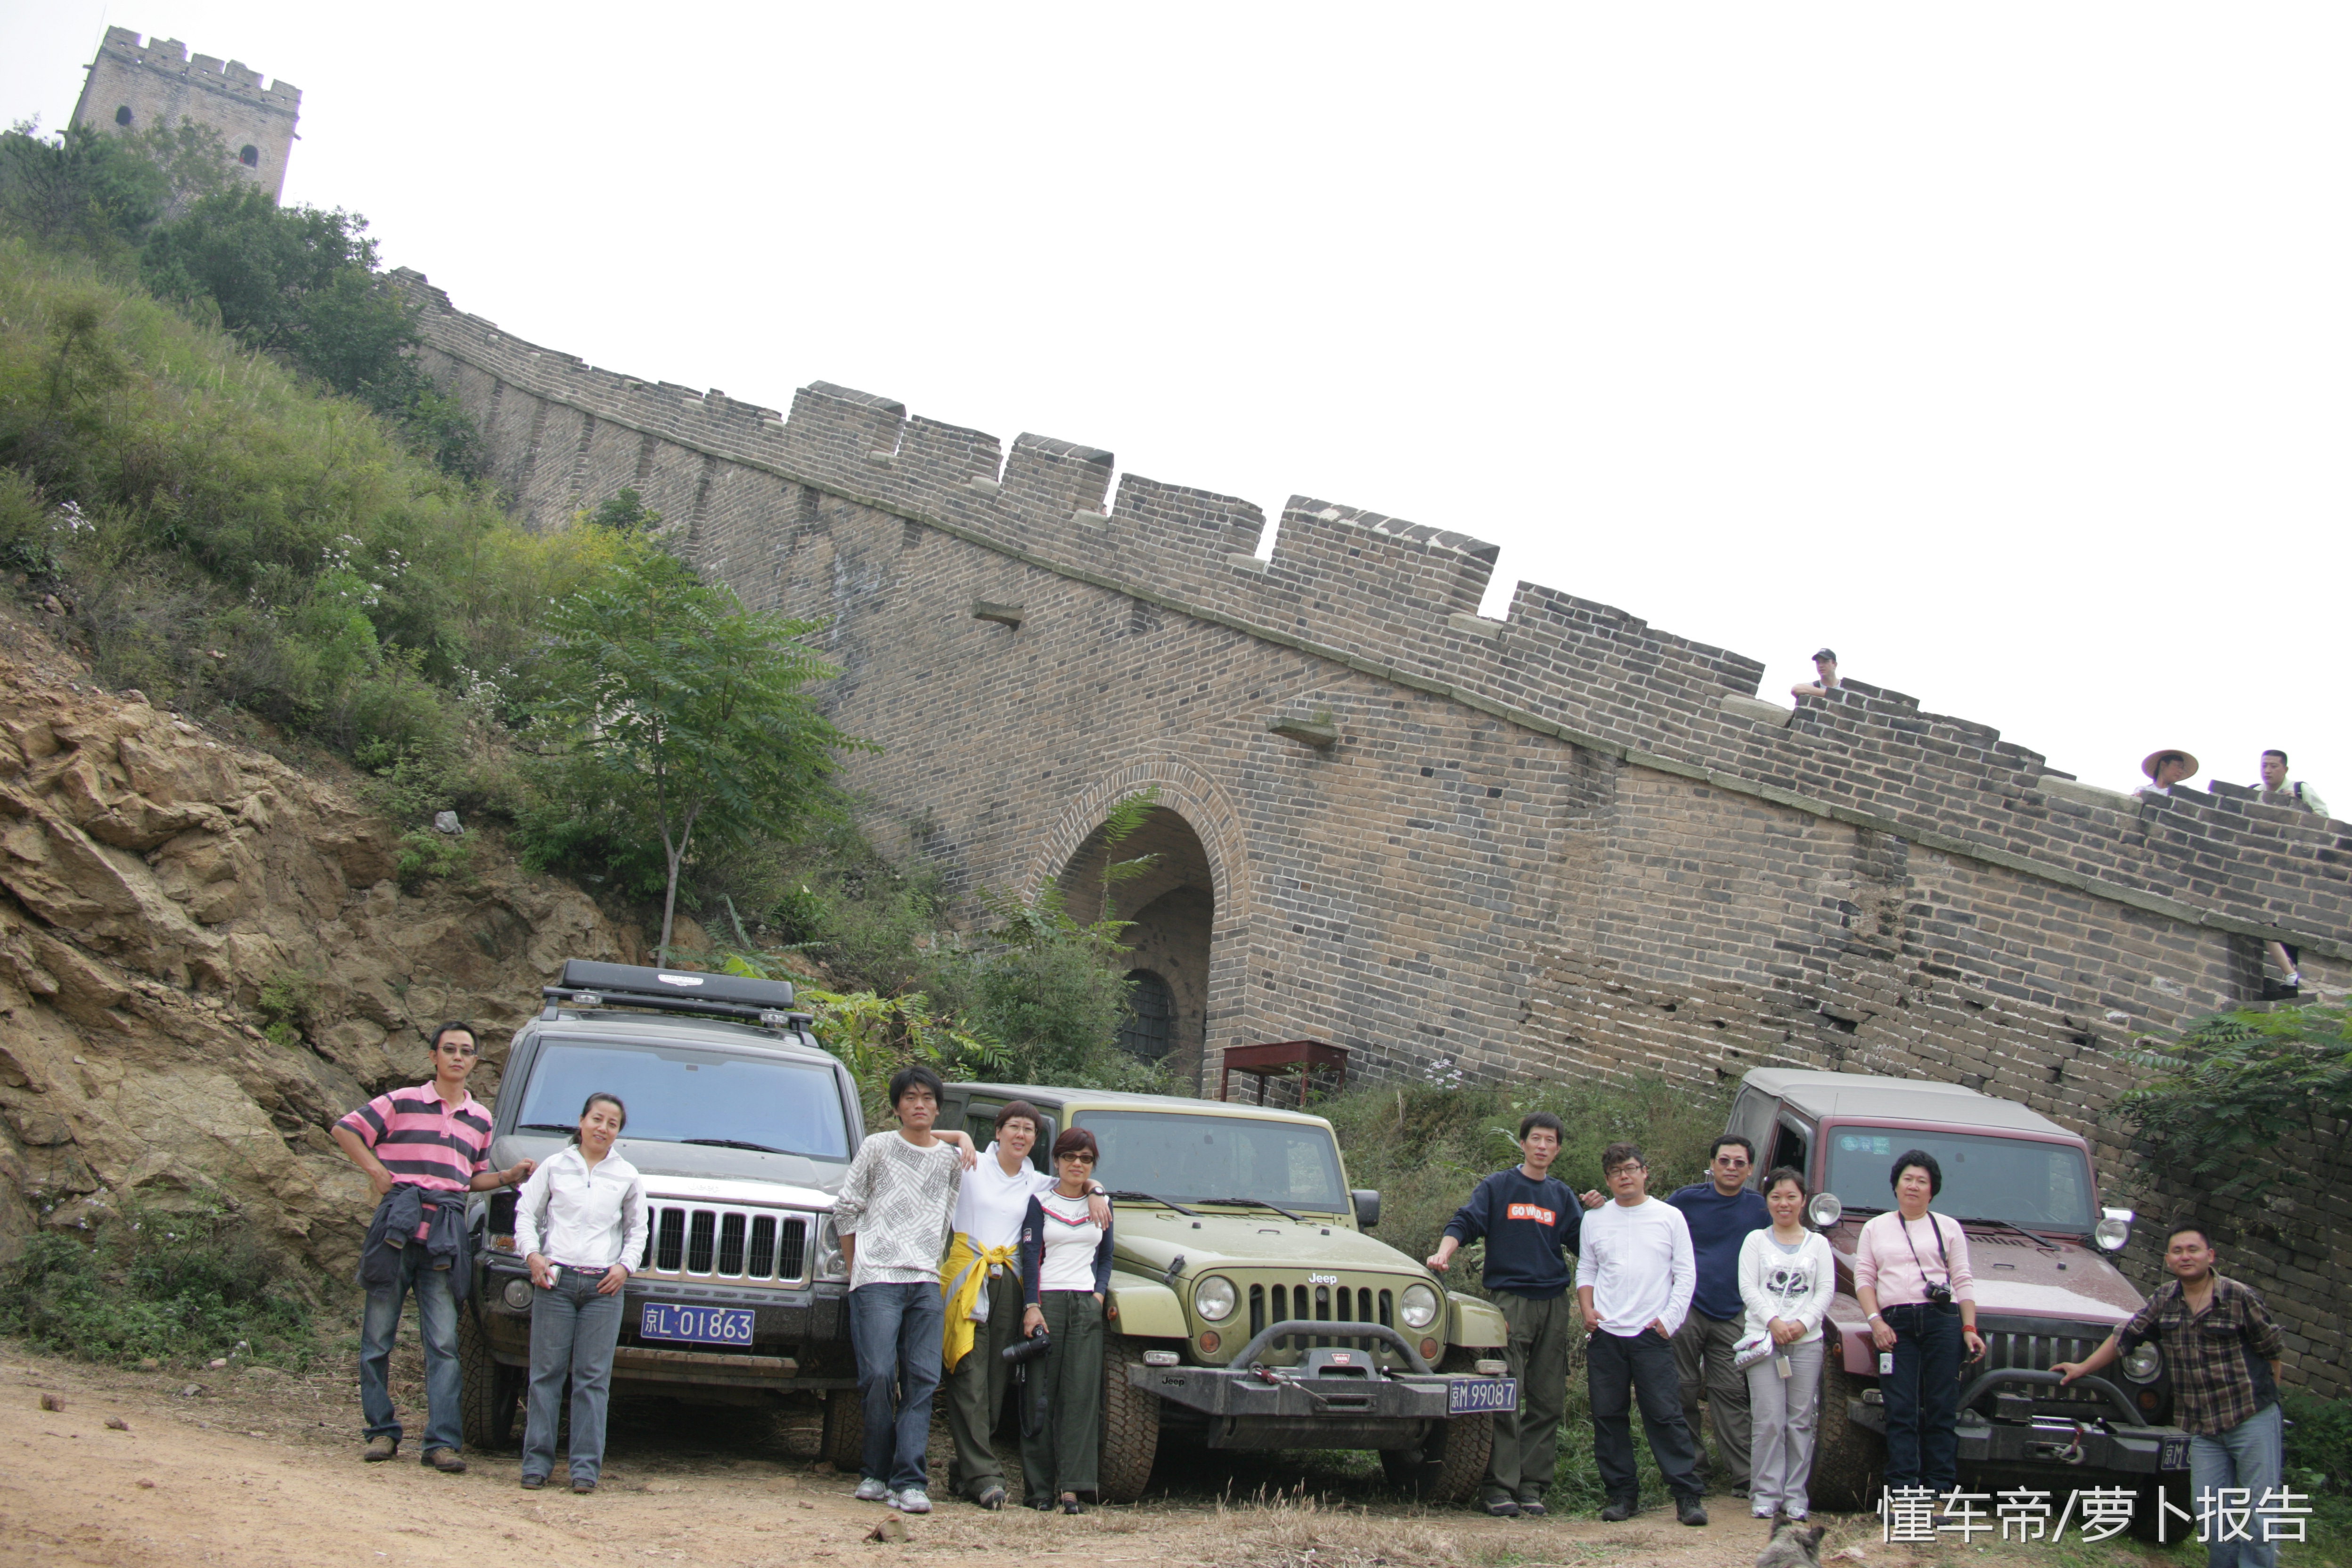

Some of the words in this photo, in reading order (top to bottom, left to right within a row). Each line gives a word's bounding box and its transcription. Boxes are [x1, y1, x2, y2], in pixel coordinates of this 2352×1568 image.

[1511, 1206, 1525, 1216] GO
[1308, 1273, 1337, 1285] Jeep
[1162, 1377, 1184, 1387] Jeep
